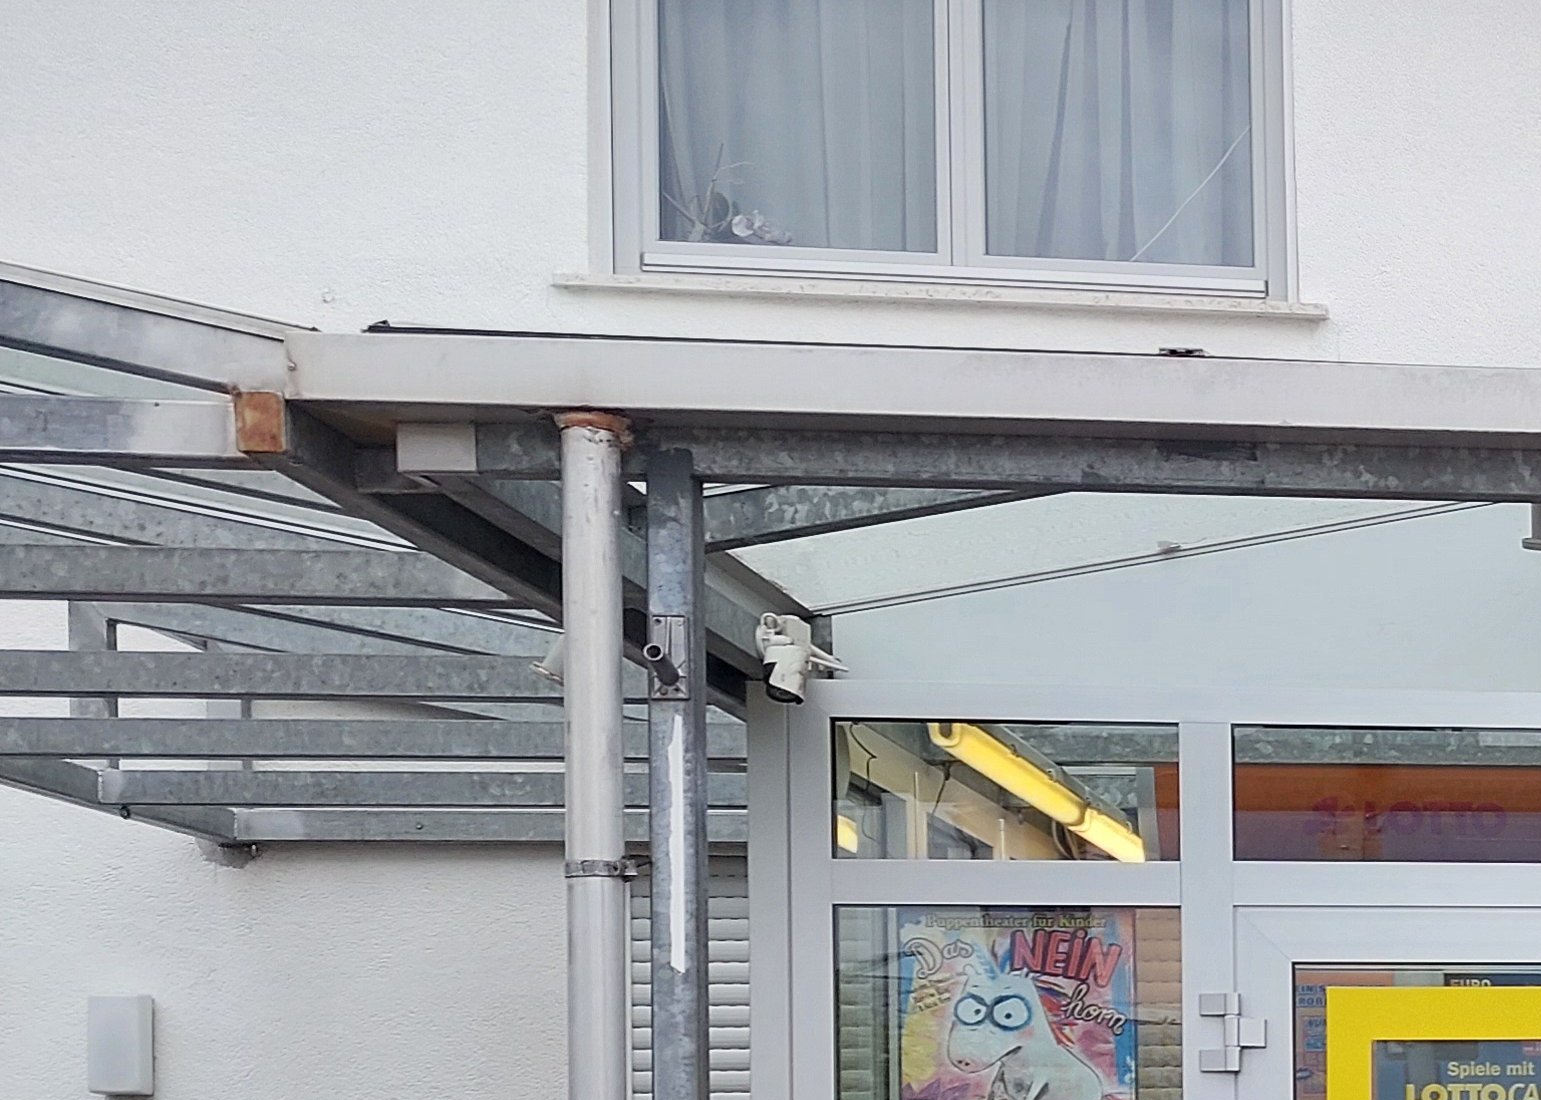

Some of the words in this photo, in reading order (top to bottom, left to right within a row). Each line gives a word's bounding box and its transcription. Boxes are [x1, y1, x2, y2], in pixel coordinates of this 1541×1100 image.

[926, 914, 1028, 929] Puppentheater
[1031, 914, 1054, 928] für
[1058, 913, 1106, 929] Kinder
[904, 937, 974, 979] Das
[1062, 983, 1127, 1036] horn
[1447, 1061, 1500, 1079] Spiele
[1506, 1061, 1535, 1076] mit
